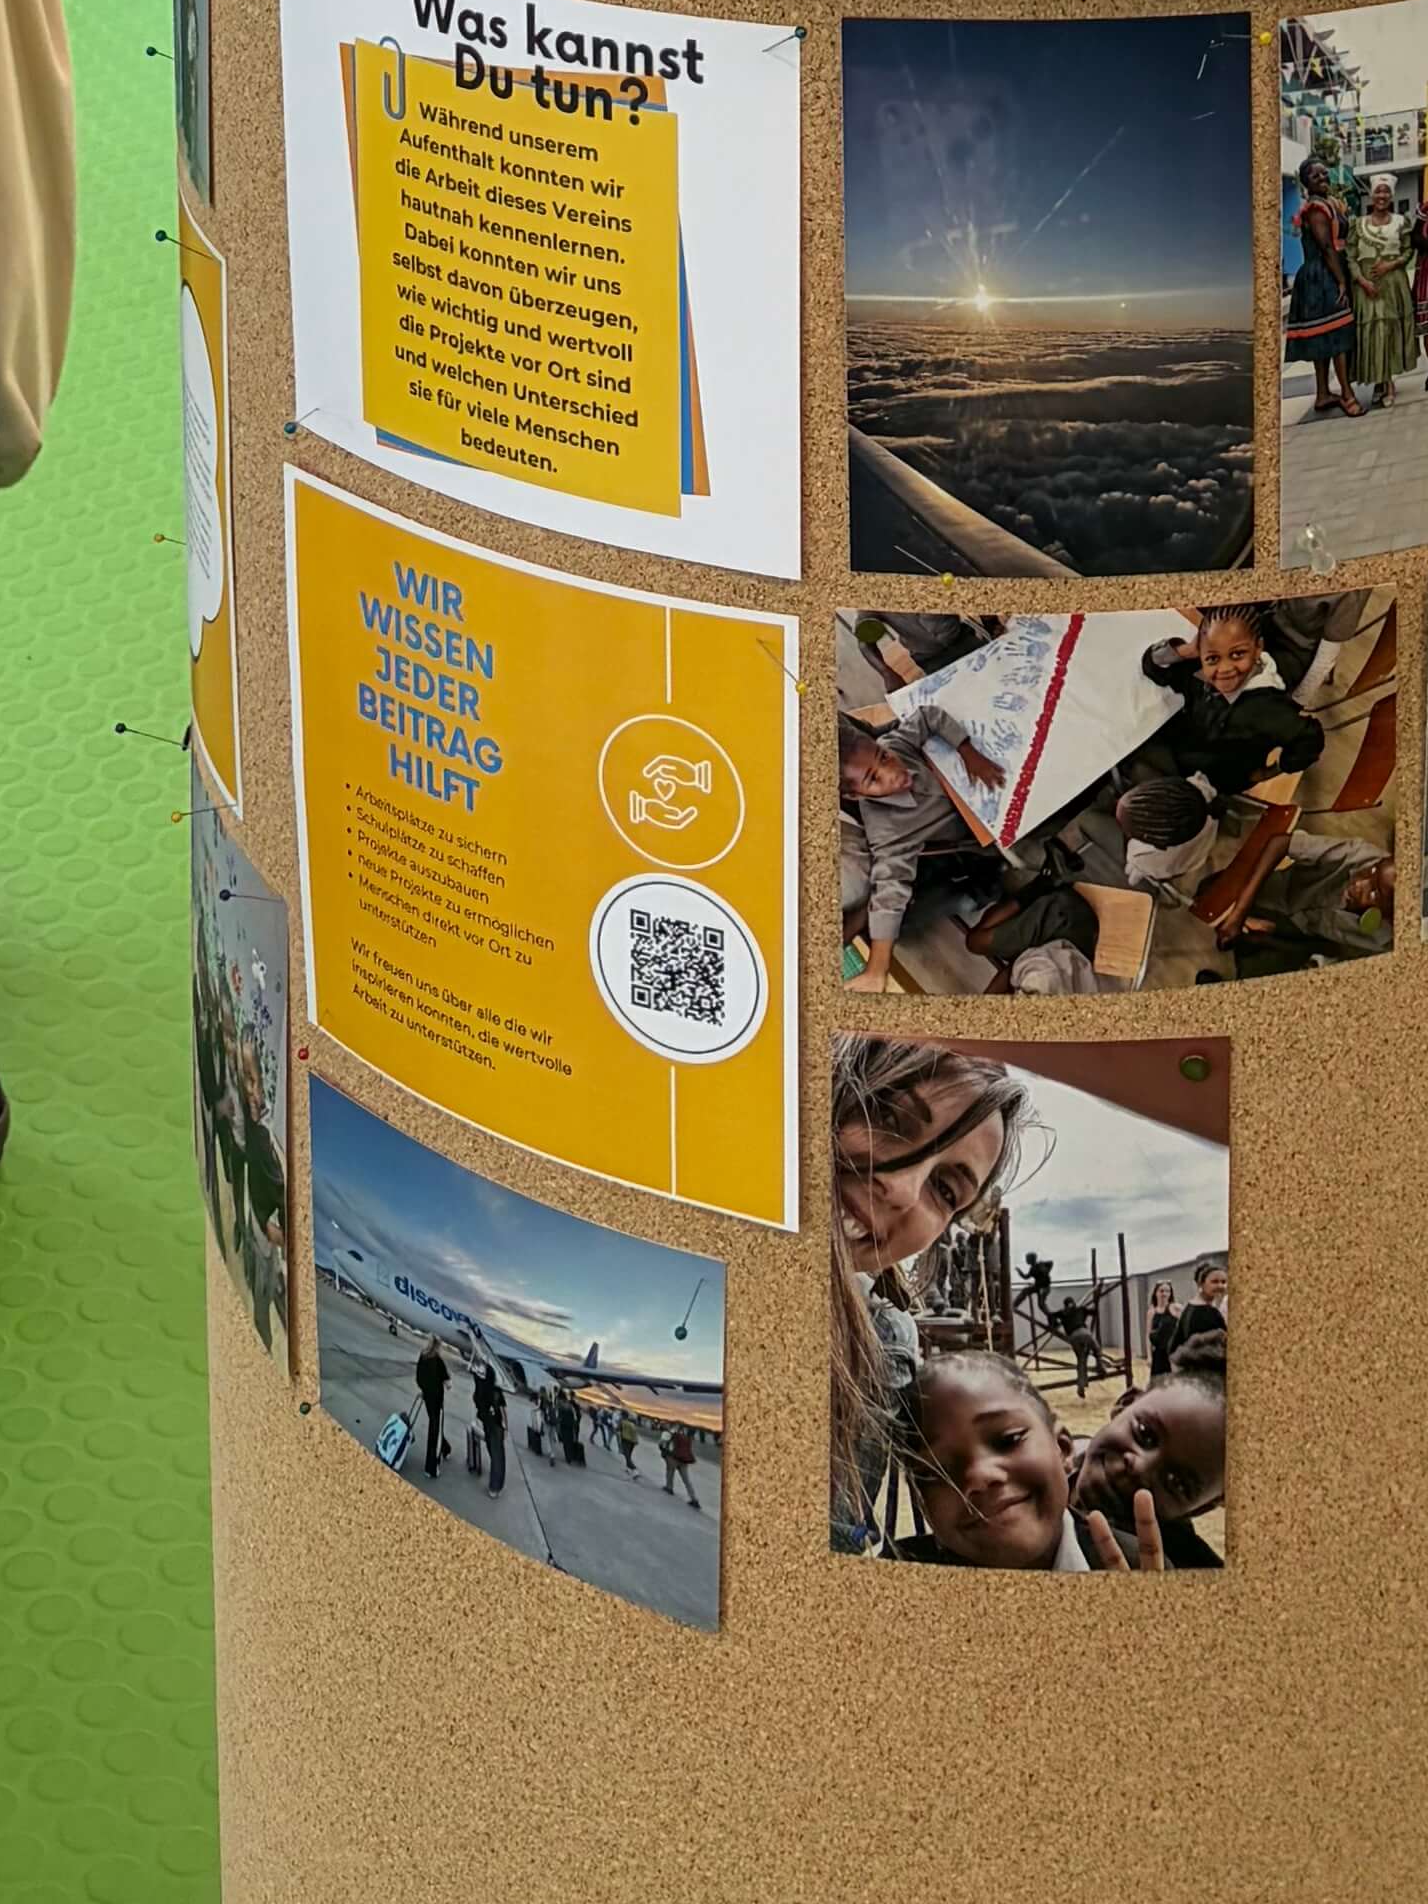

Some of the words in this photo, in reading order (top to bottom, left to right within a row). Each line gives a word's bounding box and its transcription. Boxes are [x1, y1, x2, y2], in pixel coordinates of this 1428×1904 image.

[525, 3, 705, 84] kannst
[454, 44, 515, 100] Du
[528, 67, 650, 126] tun?
[399, 127, 496, 172] Aufenthalt
[500, 155, 585, 193] konnten
[590, 178, 625, 200] wir
[419, 101, 504, 142] Während
[508, 129, 599, 163] unserem
[395, 157, 421, 180] die
[425, 167, 482, 200] Arbeit
[485, 184, 548, 216] dieses
[551, 200, 633, 233] Vereins
[401, 188, 474, 229] hautnah
[479, 213, 625, 265] kennenlernen.
[392, 251, 443, 282] selbst
[446, 268, 504, 301] davon
[508, 285, 638, 335] überzeugen,
[404, 221, 455, 255] Dabei
[459, 239, 539, 279] konnten
[544, 265, 578, 287] wir
[583, 275, 622, 296] uns
[396, 283, 427, 307] wie
[430, 296, 499, 334] wichtig
[504, 319, 542, 343] und
[547, 330, 633, 363] wertvoll
[399, 313, 426, 337] die
[429, 321, 506, 364] Projekte
[510, 352, 543, 374] vor
[547, 360, 582, 384] Ort
[586, 366, 632, 399] sind
[394, 344, 427, 369] und
[431, 358, 508, 397] welchen
[513, 381, 639, 428] Unterschied
[408, 379, 433, 402] sie
[436, 388, 462, 413] für
[466, 400, 510, 428] viele
[515, 414, 620, 457] Menschen
[460, 427, 558, 474] bedeuten.
[393, 560, 464, 624] WIR
[358, 590, 496, 681] WISSEN
[374, 644, 481, 722] JEDER
[357, 681, 504, 775] BEITRAG
[388, 742, 481, 815] HILFT
